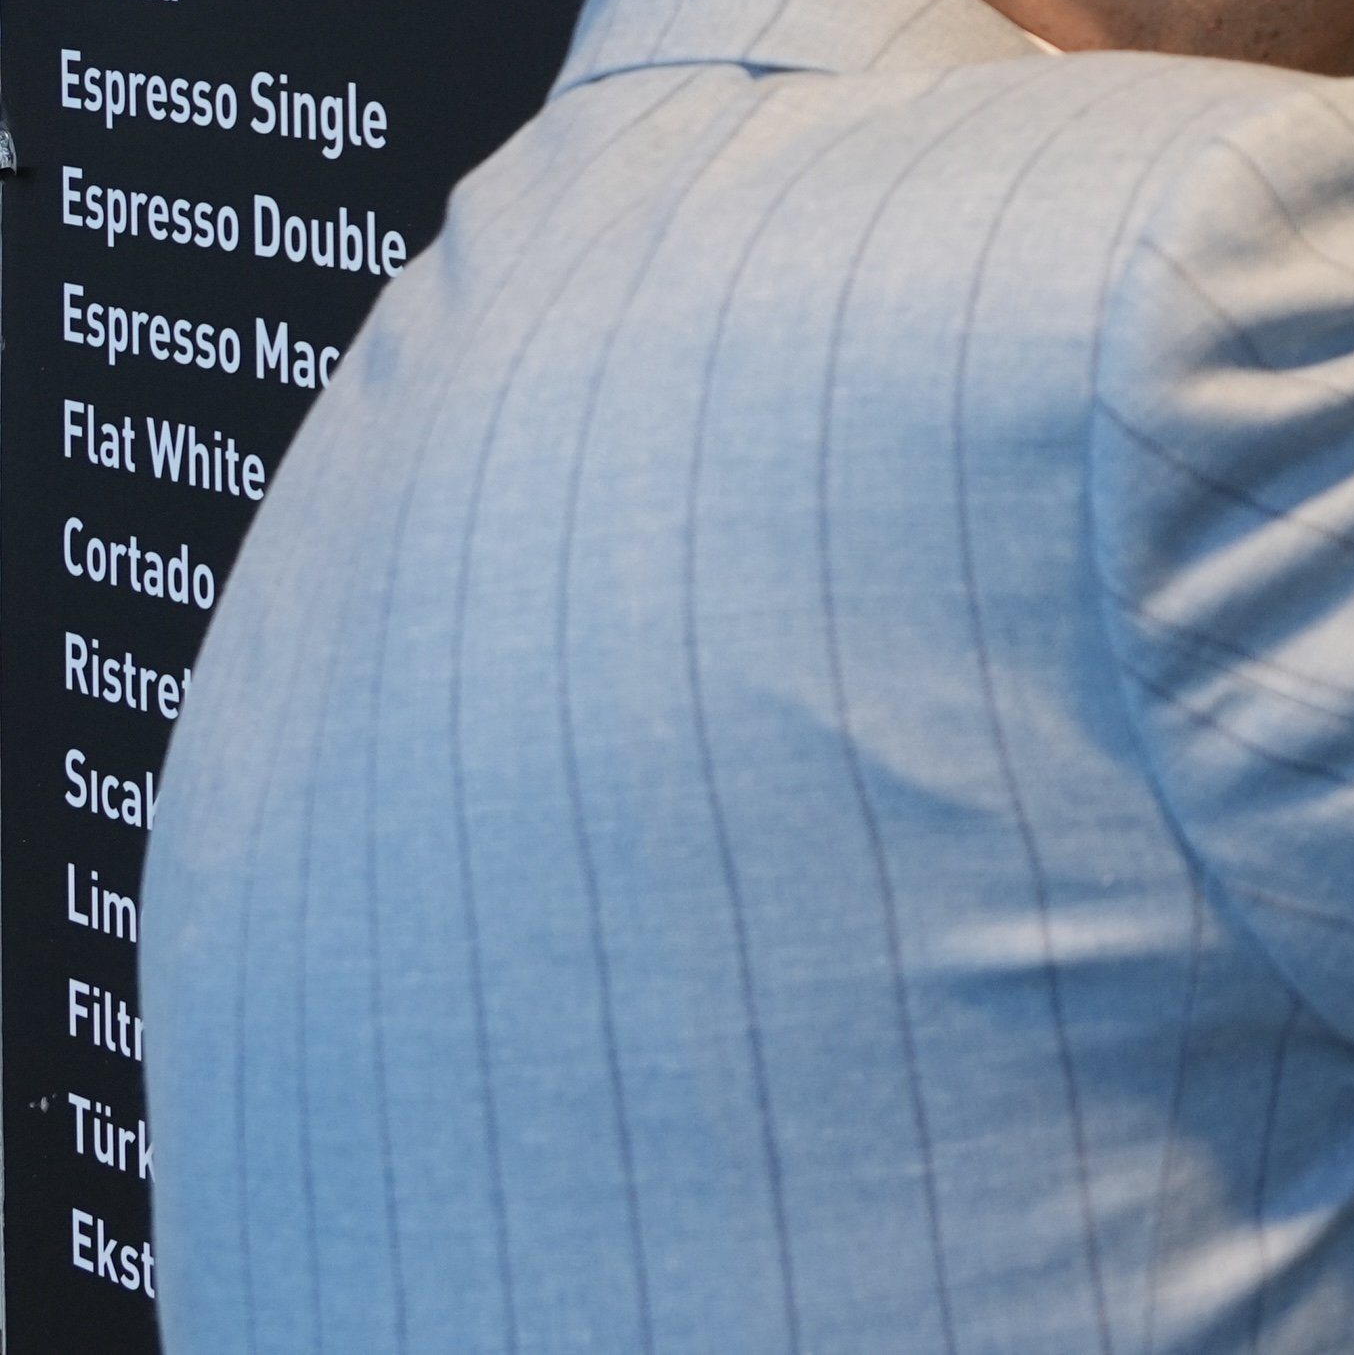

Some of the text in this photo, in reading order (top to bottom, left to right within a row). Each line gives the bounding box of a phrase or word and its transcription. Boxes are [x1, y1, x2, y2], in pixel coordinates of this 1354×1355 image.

[60, 48, 388, 160] Espresso Single
[62, 165, 407, 278] Espresso Double
[63, 282, 341, 391] Espresso Mac
[64, 399, 266, 501] Flat White
[63, 517, 215, 609] Cortado
[65, 632, 192, 720] Ristre
[68, 863, 137, 943] Lim
[69, 978, 143, 1062] Filtr
[72, 1208, 155, 1299] Ekst
